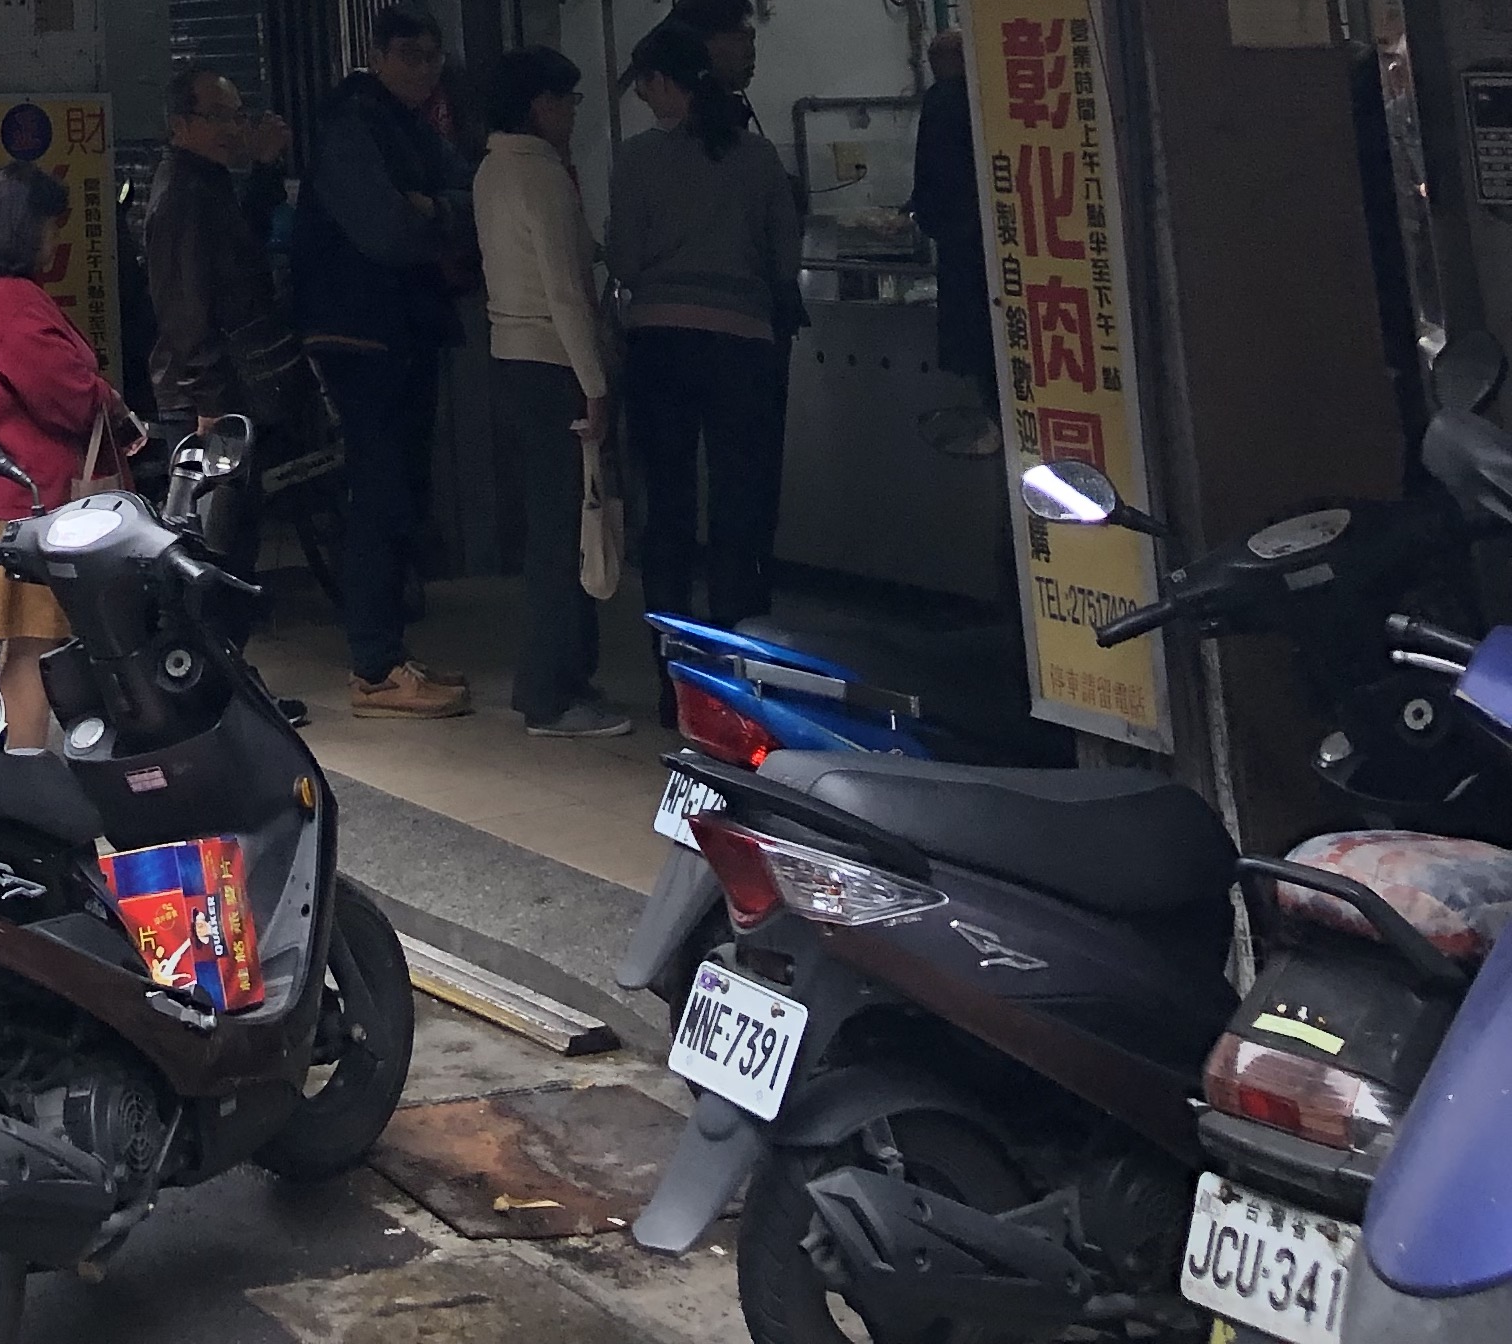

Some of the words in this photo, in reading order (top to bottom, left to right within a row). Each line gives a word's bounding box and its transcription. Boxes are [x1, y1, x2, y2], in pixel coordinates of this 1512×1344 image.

[66, 107, 106, 155] 財
[206, 895, 225, 956] QUAKER
[680, 992, 790, 1090] MNE-7391
[1188, 1220, 1344, 1332] JCU-341
